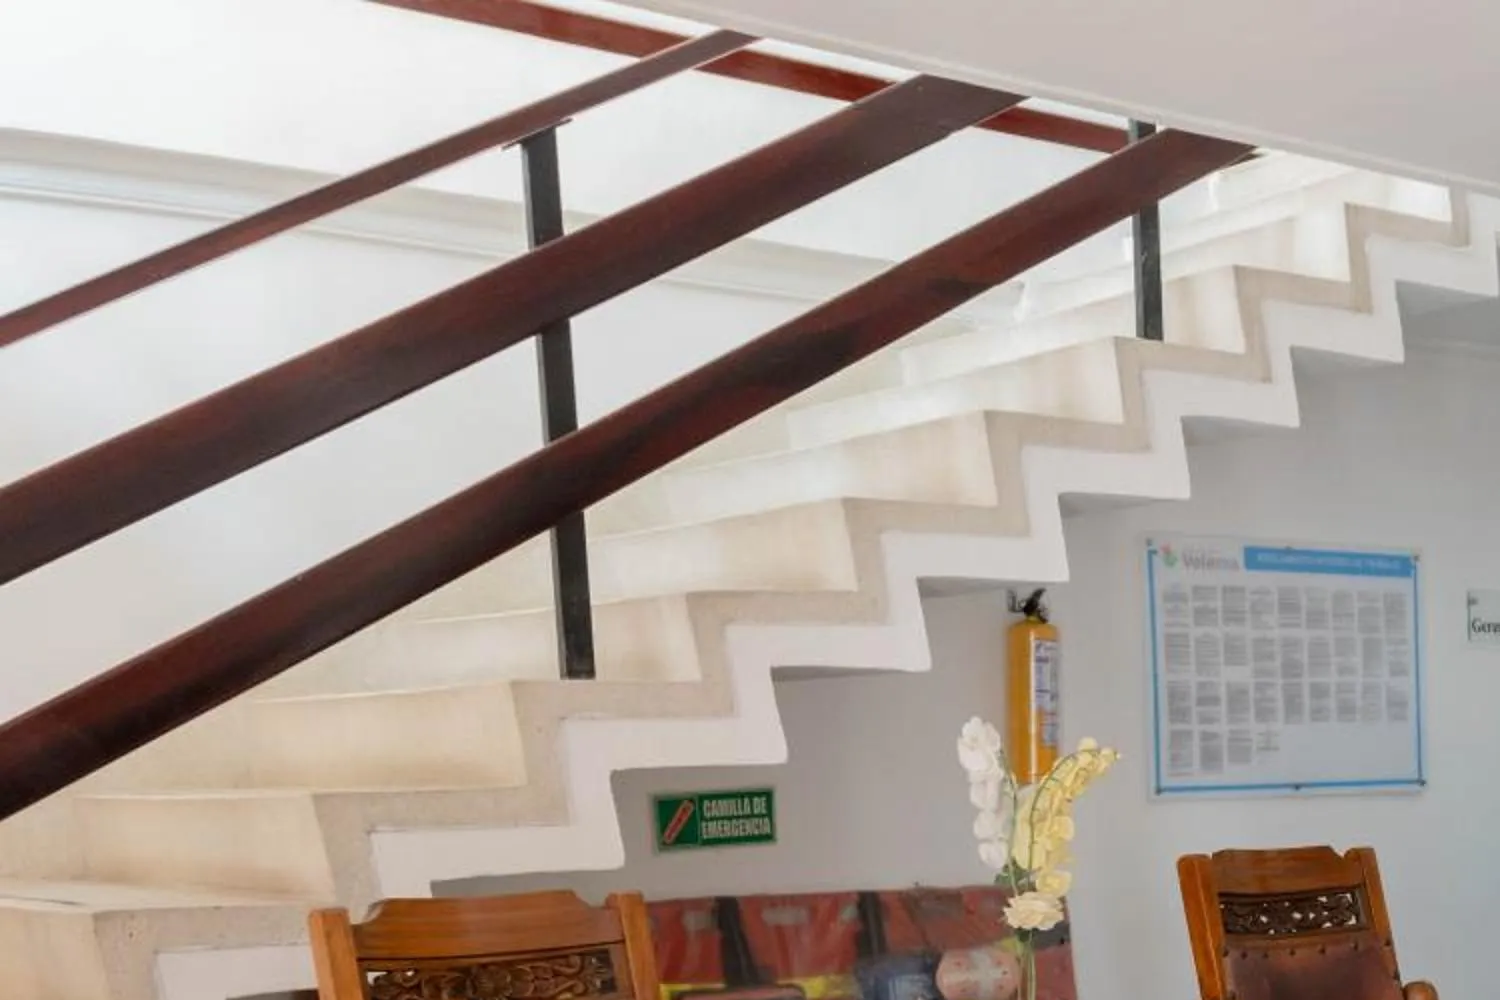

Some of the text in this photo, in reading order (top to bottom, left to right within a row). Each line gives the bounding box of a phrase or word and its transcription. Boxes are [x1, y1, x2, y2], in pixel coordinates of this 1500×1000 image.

[703, 796, 767, 818] CAMILLA DE
[701, 816, 771, 839] EMERGENCIA
